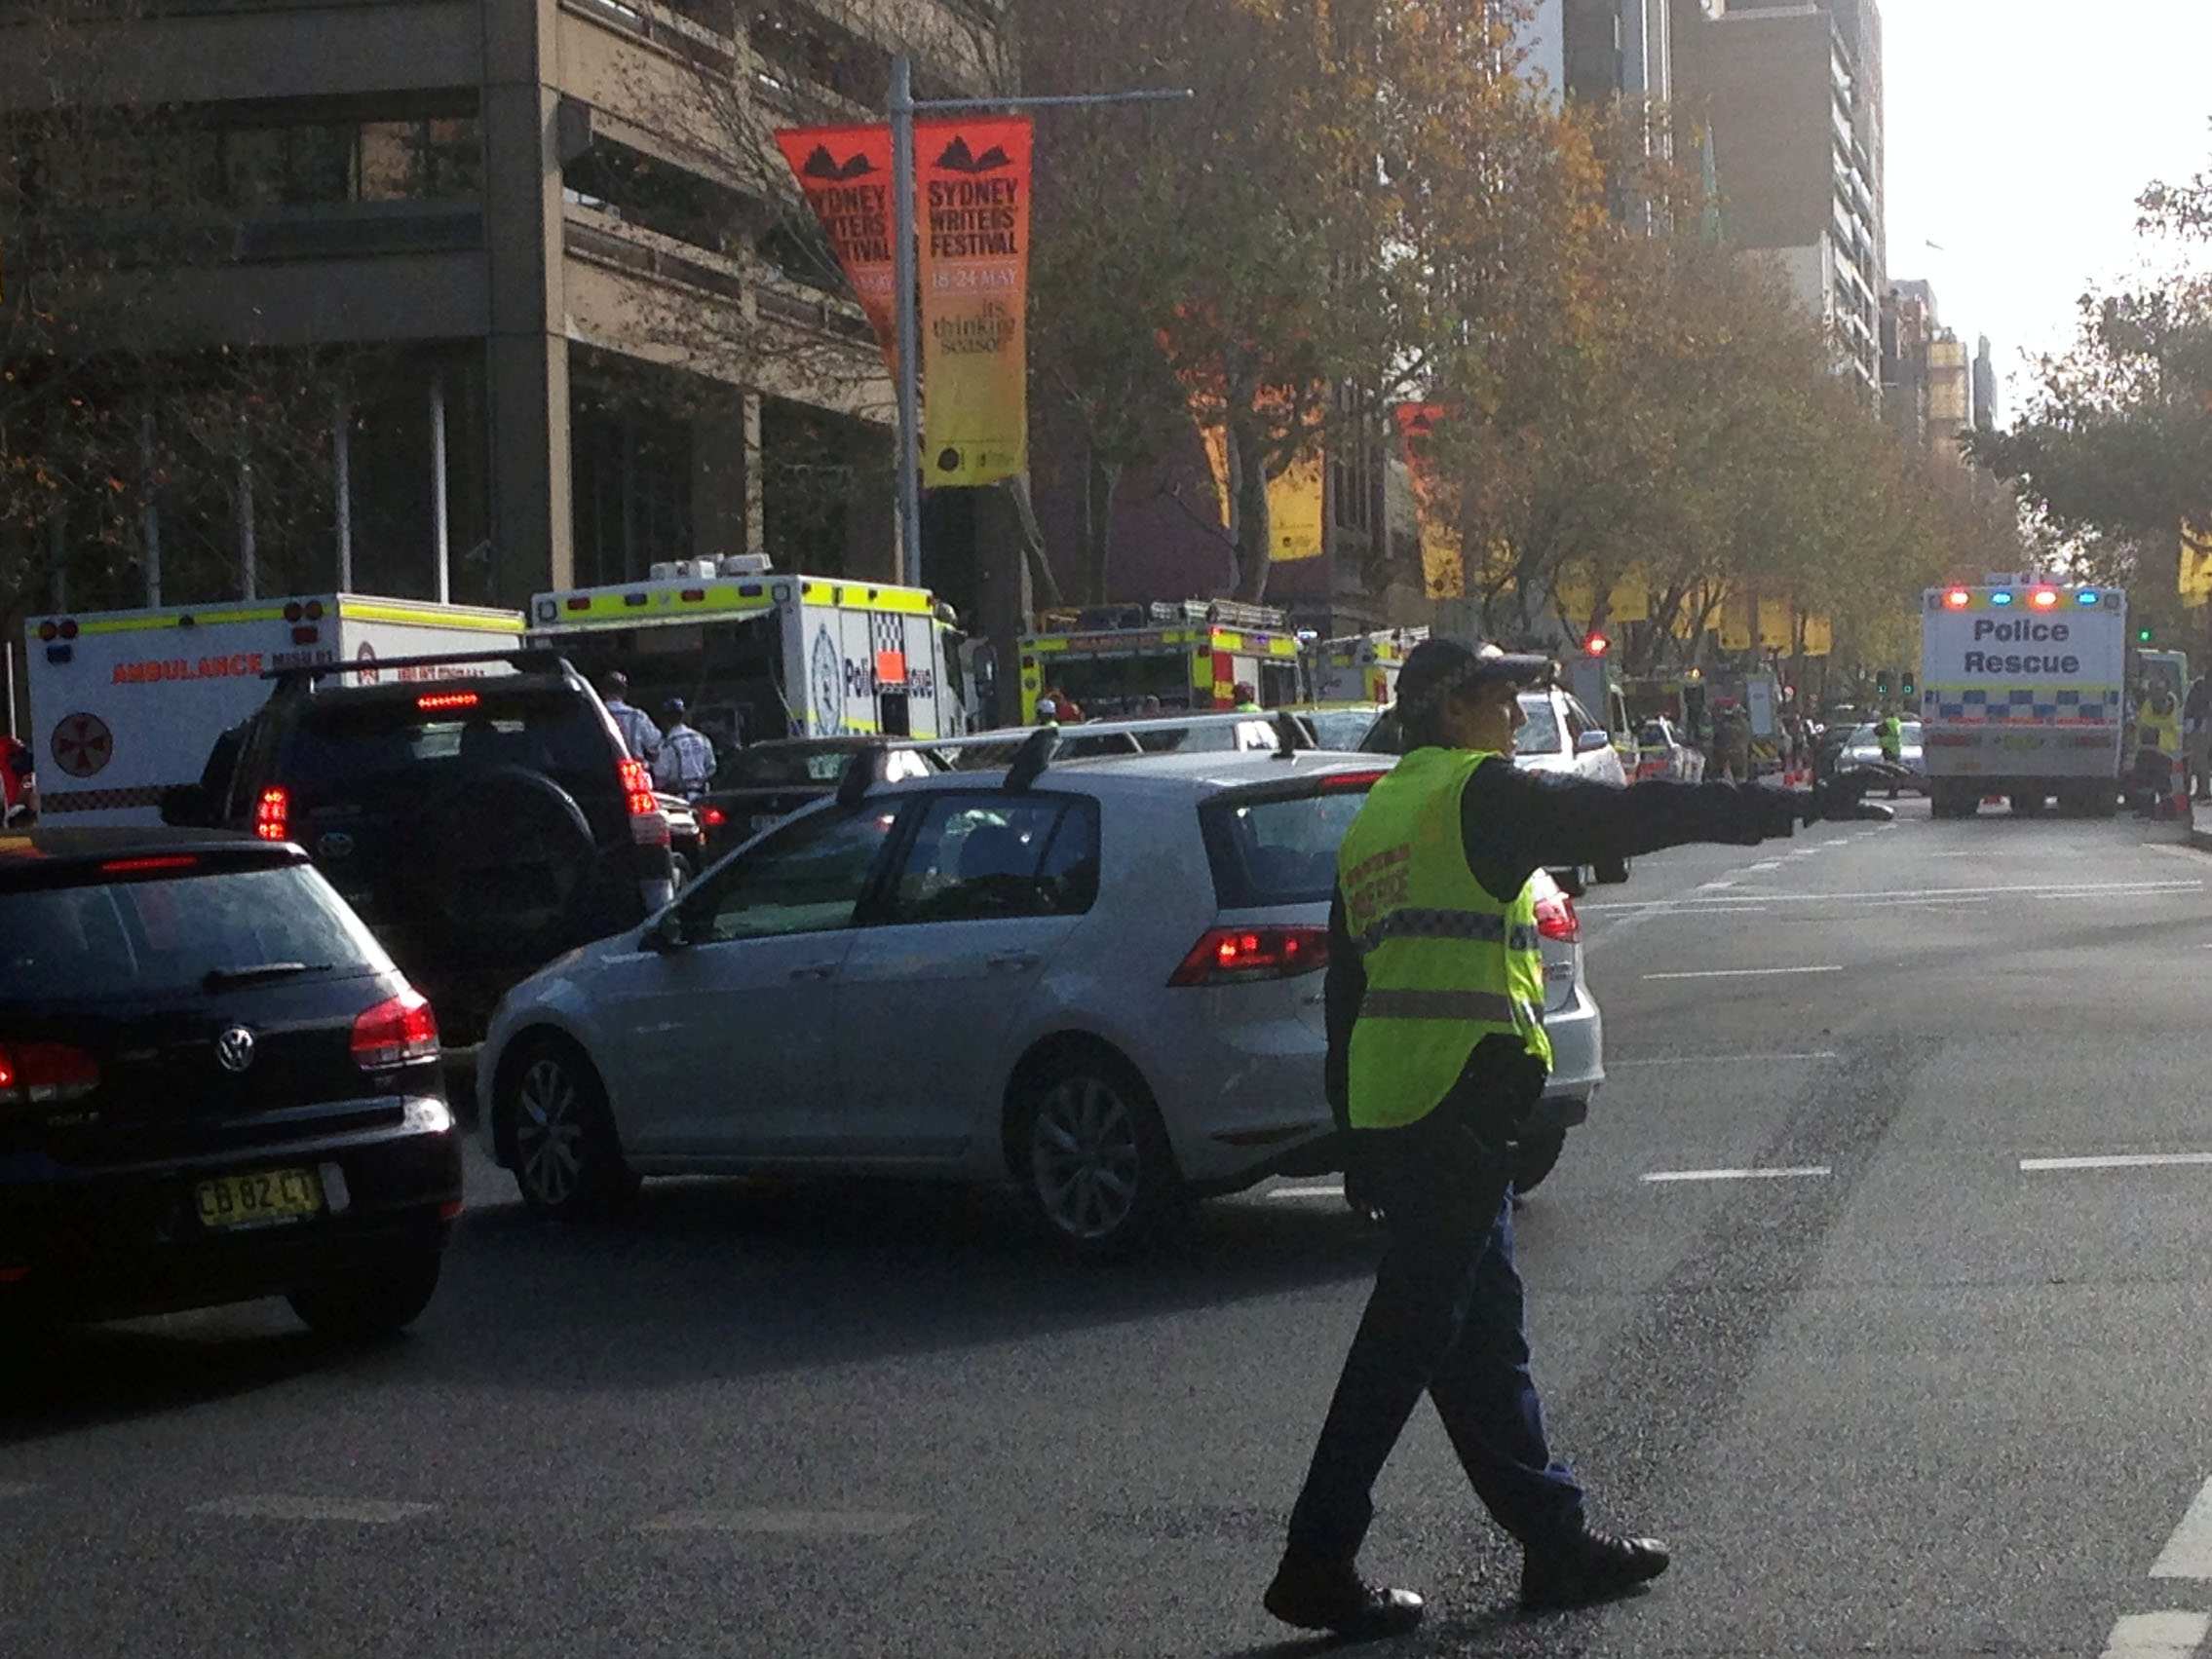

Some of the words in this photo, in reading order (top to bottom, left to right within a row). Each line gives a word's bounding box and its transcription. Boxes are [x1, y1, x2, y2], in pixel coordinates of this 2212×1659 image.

[809, 183, 886, 216] YDNEY
[929, 178, 1018, 207] SYDNEY
[930, 232, 1018, 258] FESTIVAL
[1974, 620, 2070, 642] Police
[112, 653, 263, 685] AMBULANCE
[1964, 651, 2079, 674] Rescue
